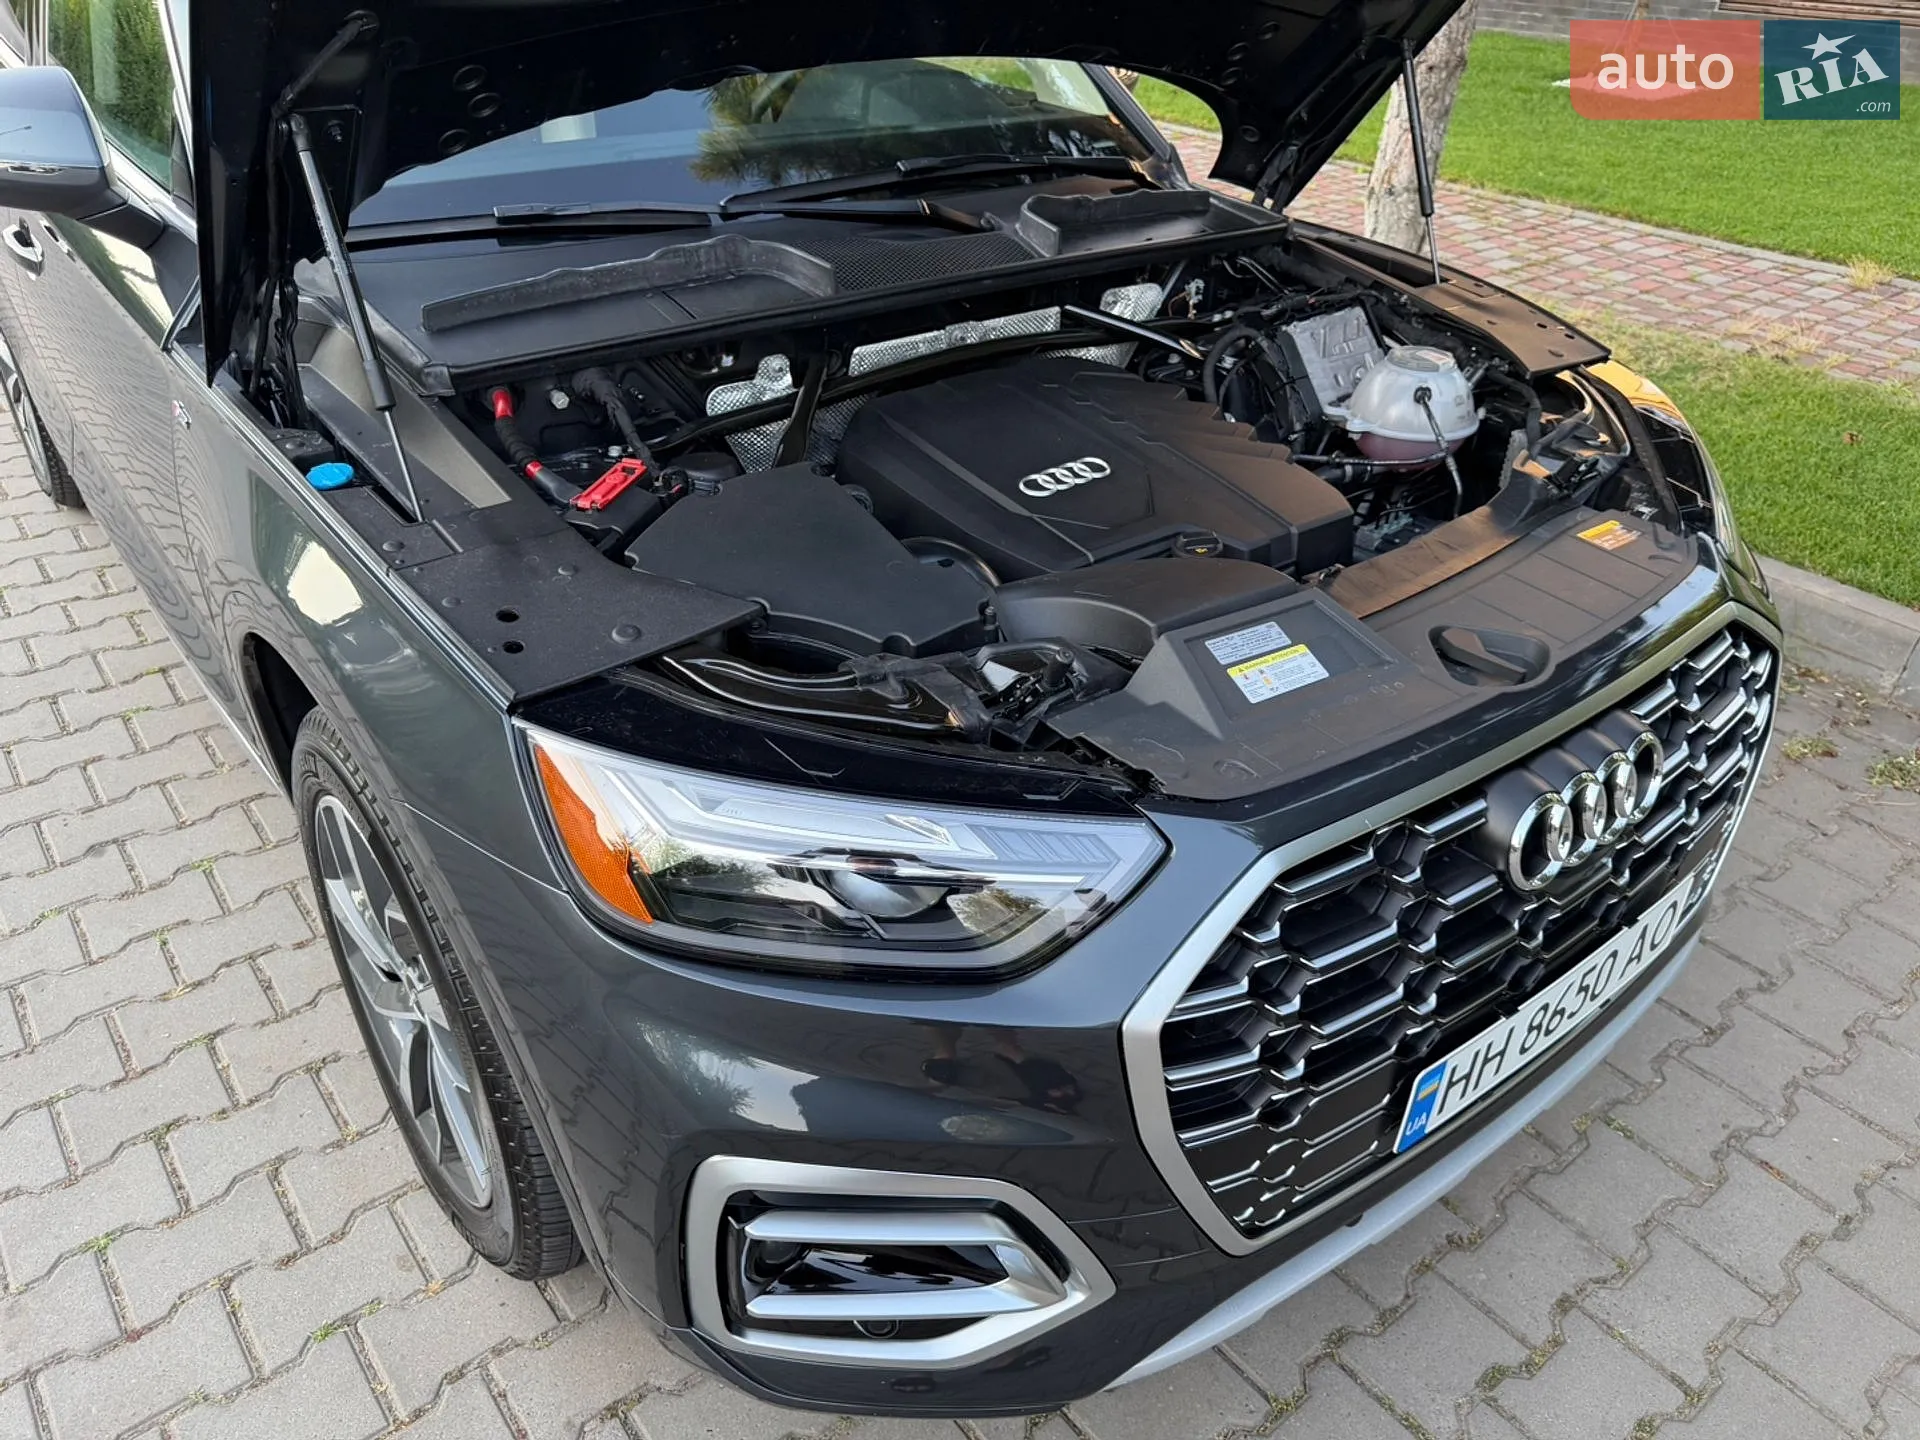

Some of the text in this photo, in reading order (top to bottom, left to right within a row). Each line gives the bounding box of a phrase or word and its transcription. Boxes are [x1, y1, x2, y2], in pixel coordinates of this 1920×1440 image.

[1437, 900, 1678, 1117] HH 8650 AO
[1405, 1112, 1427, 1136] UA
